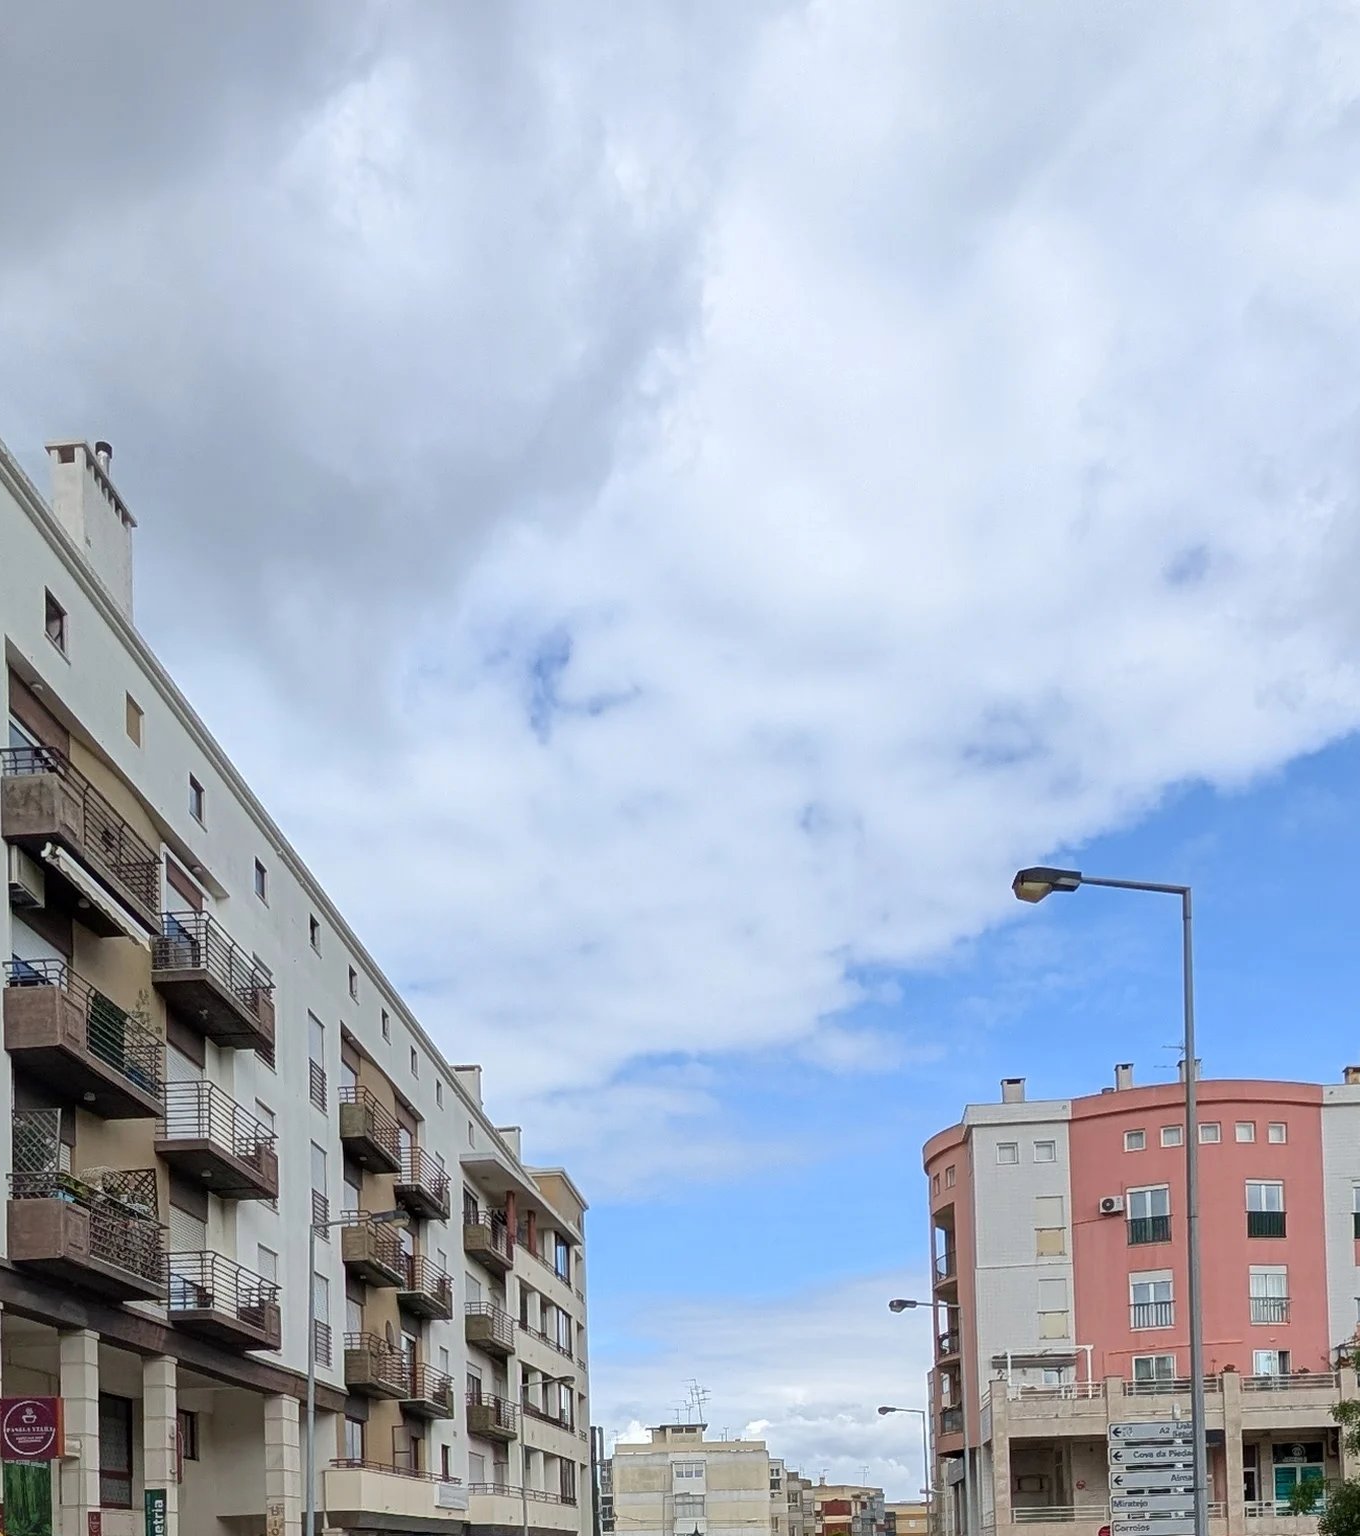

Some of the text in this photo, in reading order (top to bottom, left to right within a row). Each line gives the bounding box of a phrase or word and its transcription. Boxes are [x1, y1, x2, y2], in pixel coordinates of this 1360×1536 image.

[1169, 1449, 1193, 1457] Pieda
[1114, 1500, 1148, 1508] Miratejo
[1115, 1524, 1150, 1532] Corroios
